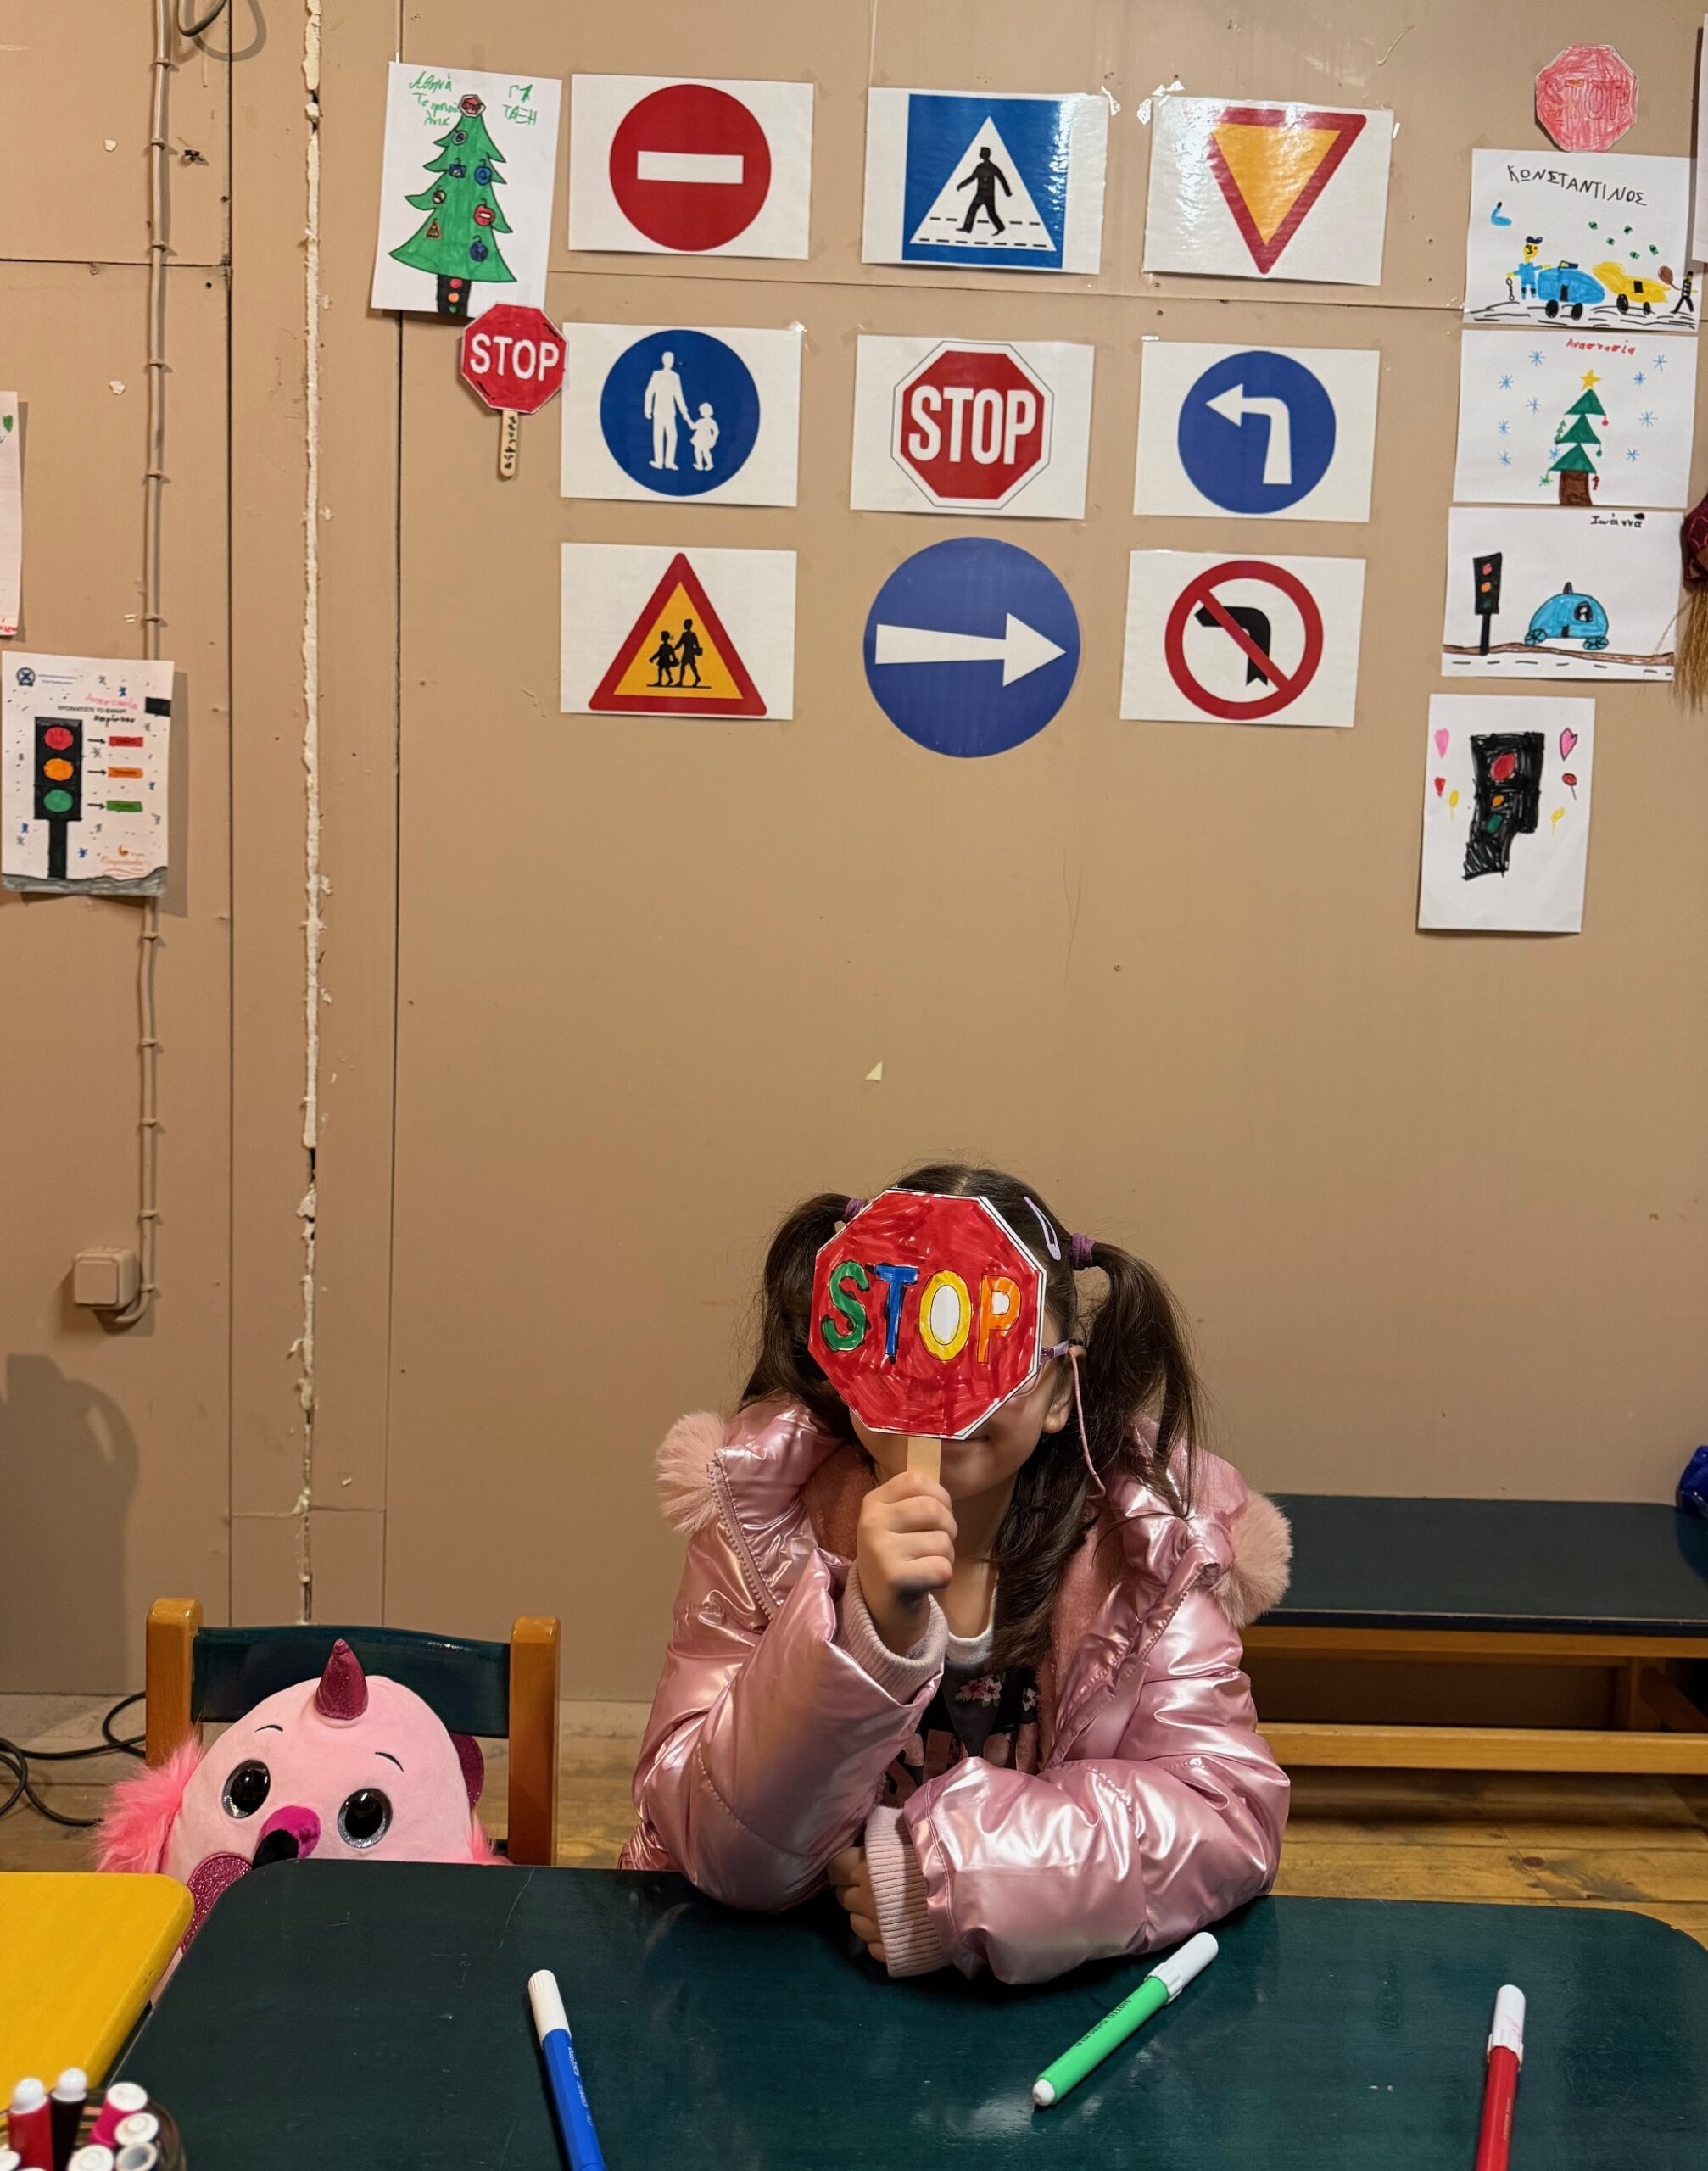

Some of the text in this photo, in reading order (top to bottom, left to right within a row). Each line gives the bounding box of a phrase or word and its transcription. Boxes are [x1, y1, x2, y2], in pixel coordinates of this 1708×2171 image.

[1507, 165, 1648, 206] ΚΩΝΣΤΑΝΤΙΝΟΣ
[469, 332, 560, 382] STOP
[907, 384, 1037, 465] STOP
[821, 1260, 1022, 1365] STOP
